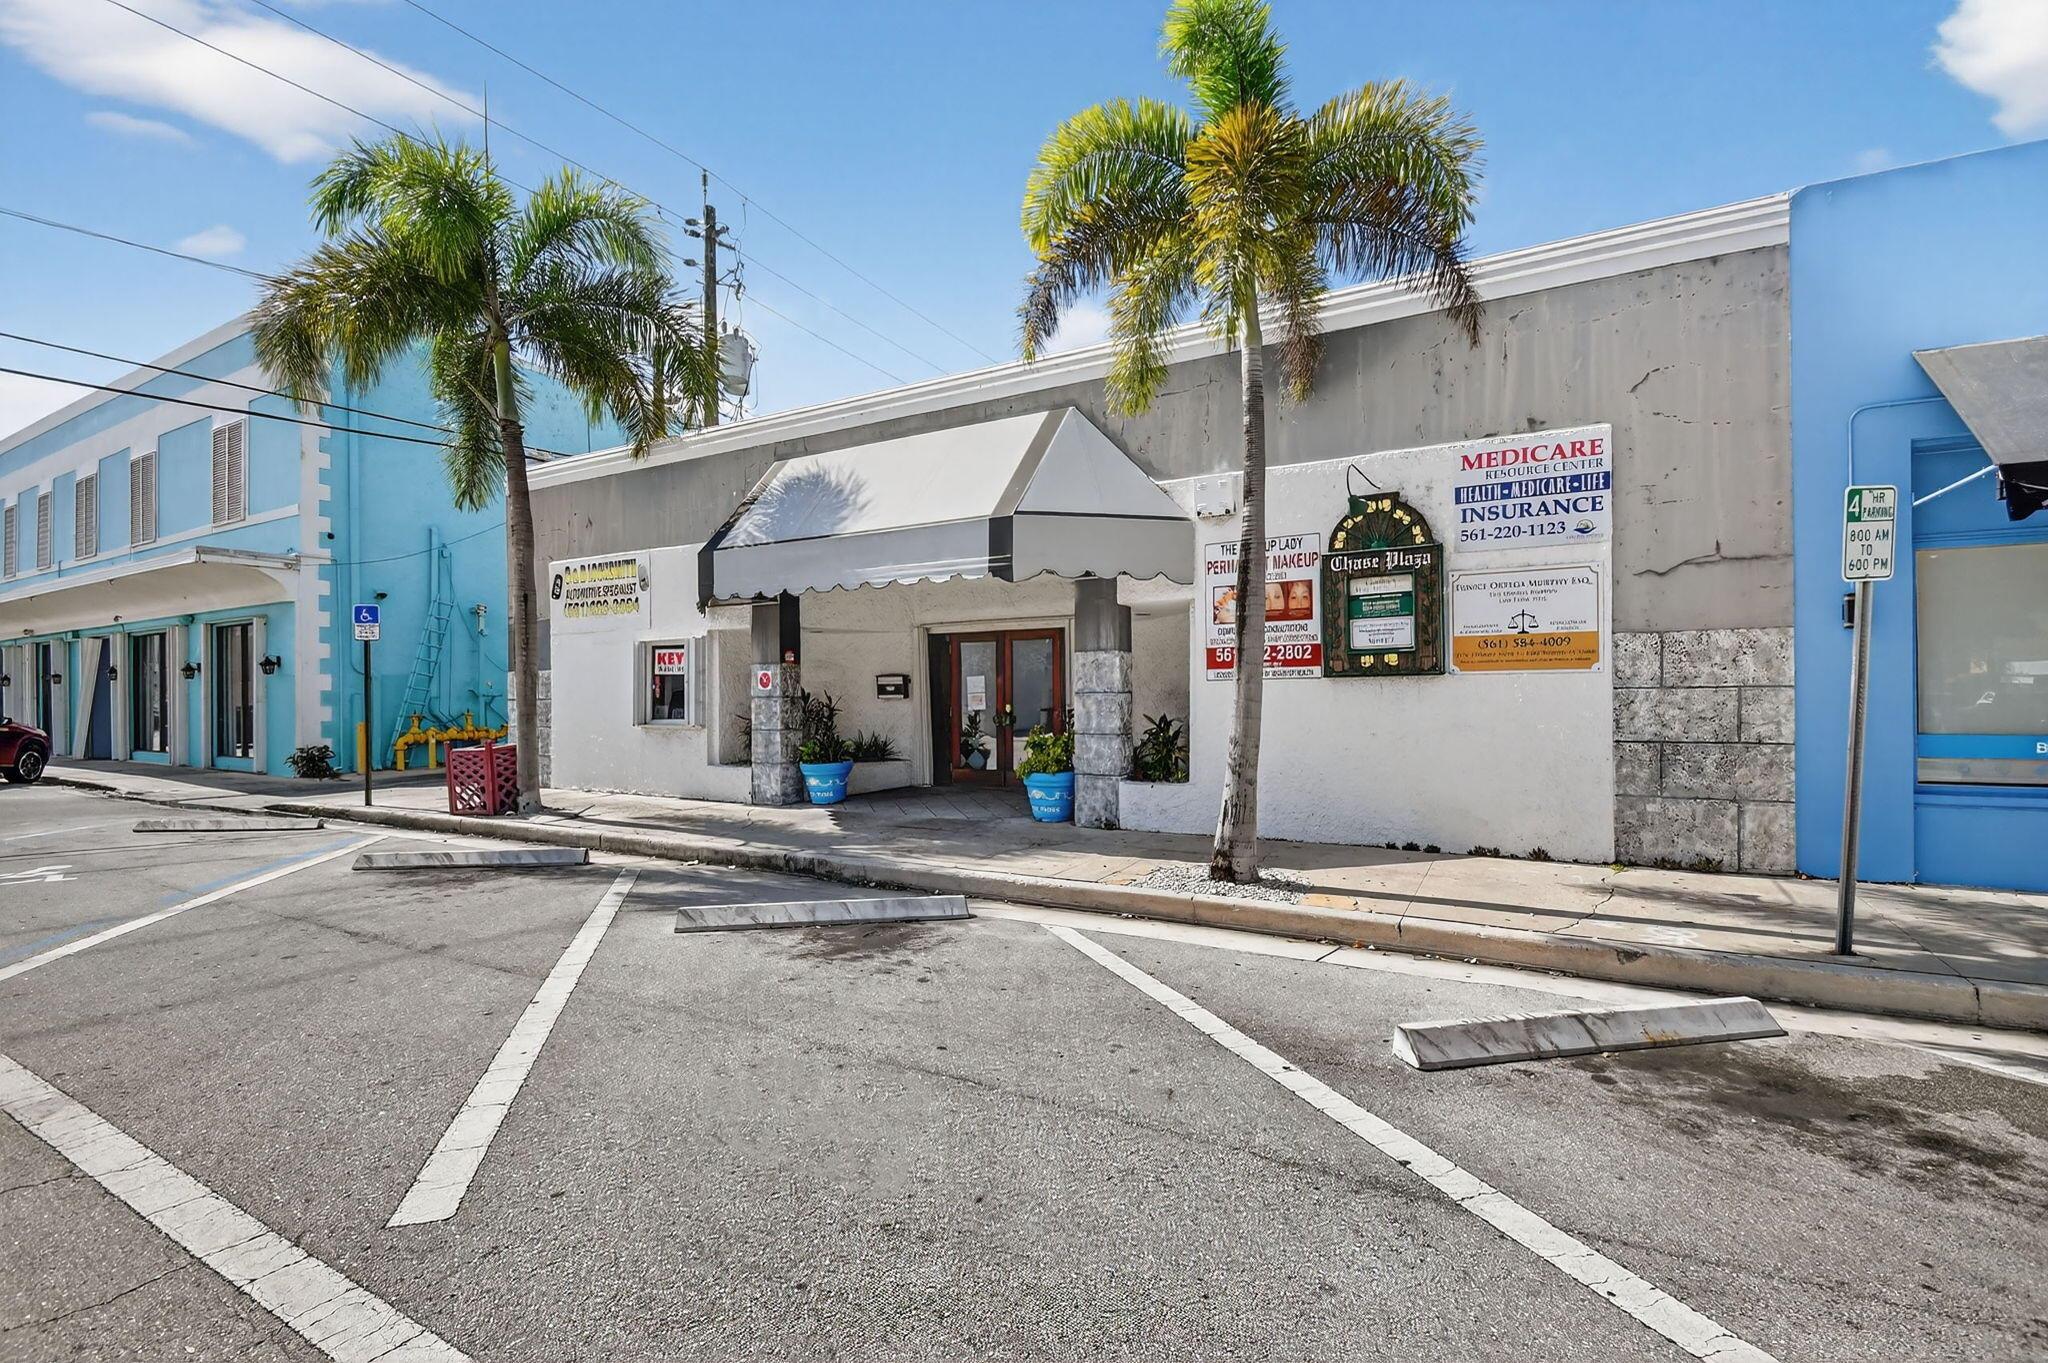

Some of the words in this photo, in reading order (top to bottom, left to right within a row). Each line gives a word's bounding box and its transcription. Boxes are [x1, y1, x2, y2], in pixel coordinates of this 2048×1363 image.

[1460, 438, 1604, 471] MEDICARE
[1485, 464, 1550, 480] RESOURCE
[1553, 457, 1604, 472] CENTER
[1460, 484, 1501, 503] HEALTH
[1511, 476, 1571, 498] MEDICARE
[1581, 472, 1605, 491] LIFE
[1460, 495, 1604, 524] INSURANCE
[1848, 494, 1860, 517] 4
[1872, 492, 1885, 503] HR
[1460, 521, 1566, 542] 561-220-1123
[1875, 528, 1889, 541] AM
[1220, 543, 1238, 556] THE
[1279, 537, 1304, 551] LADY
[1861, 544, 1872, 556] TO
[1272, 552, 1319, 571] MAKEUP
[1330, 555, 1379, 574] Chase
[1385, 551, 1431, 570] Plaza
[1873, 557, 1888, 570] PM
[657, 652, 684, 665] KEY
